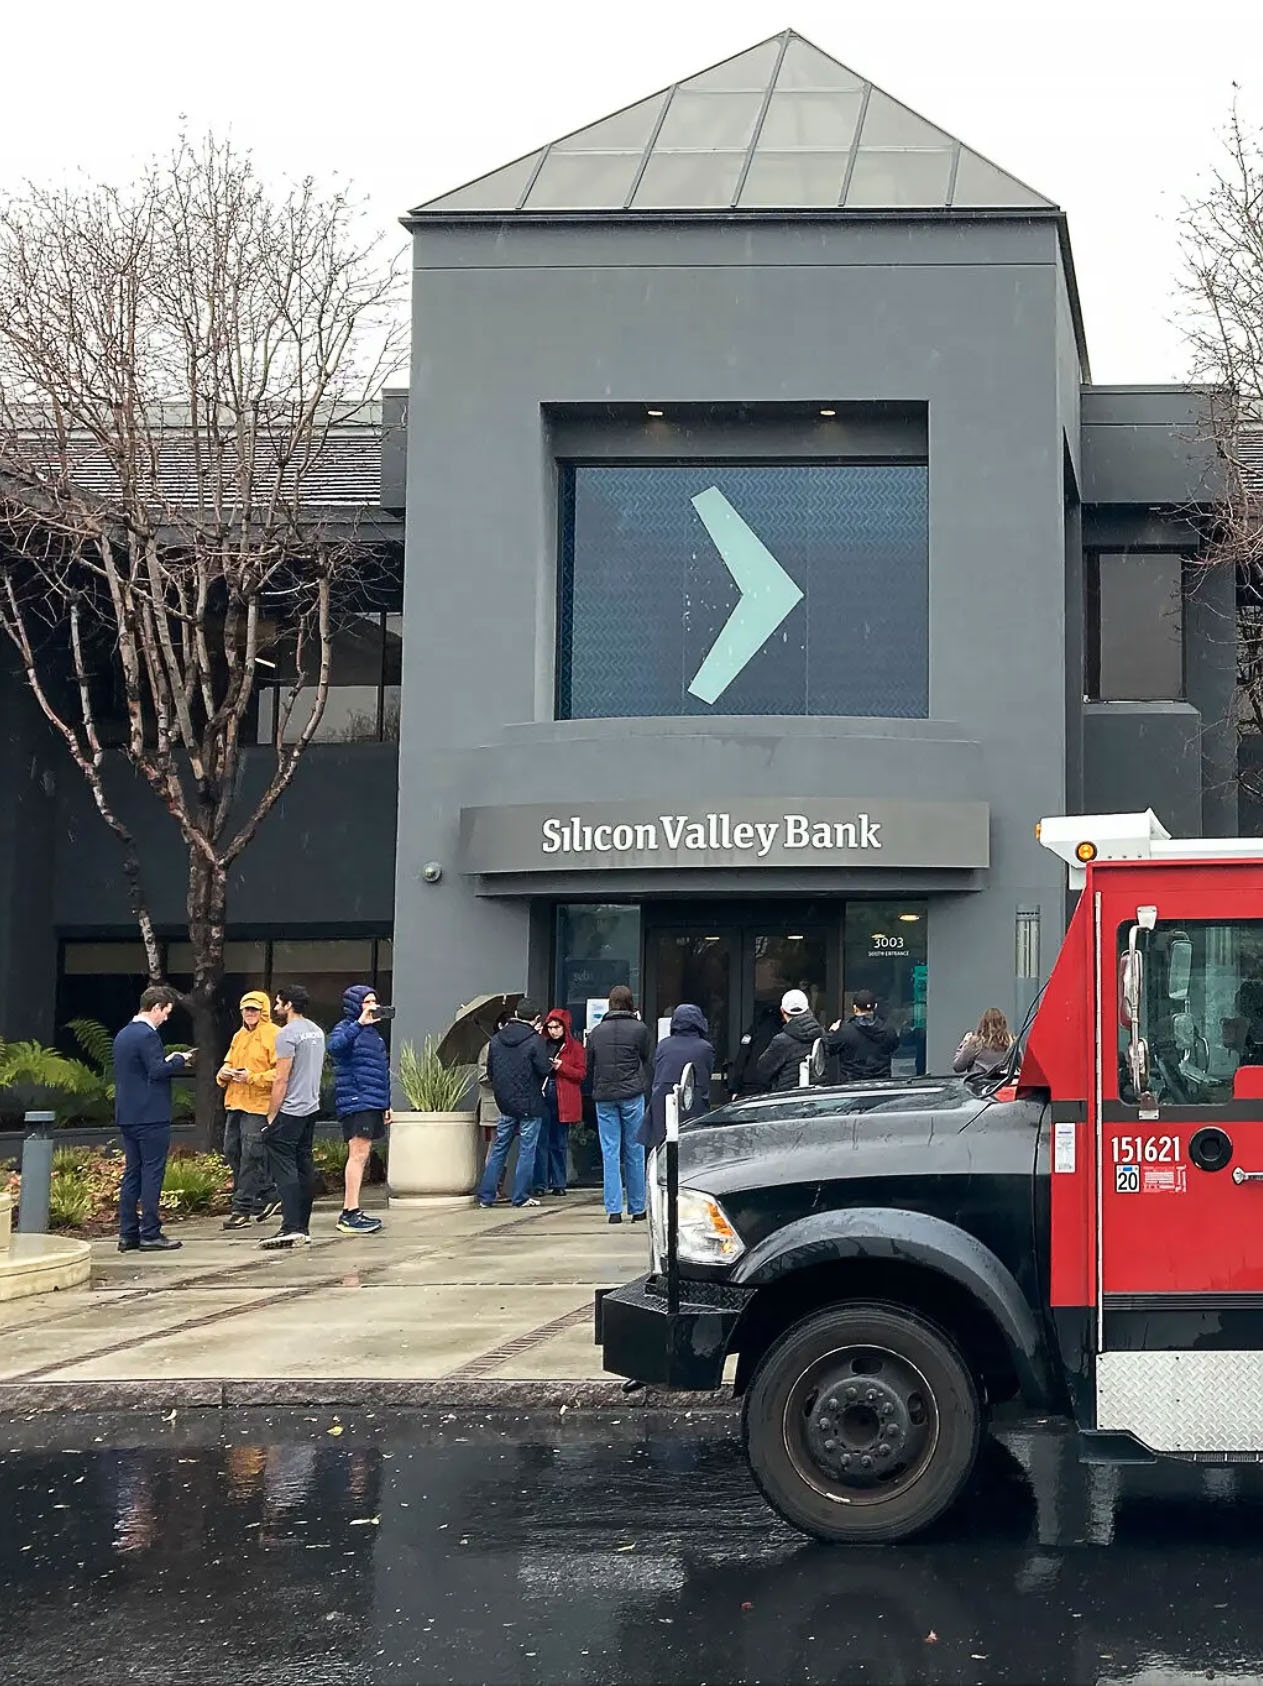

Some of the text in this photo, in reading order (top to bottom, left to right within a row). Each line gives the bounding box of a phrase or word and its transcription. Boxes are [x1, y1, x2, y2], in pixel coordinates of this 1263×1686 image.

[659, 813, 779, 857] Valley
[783, 813, 882, 849] Bank
[873, 936, 904, 949] 3003
[1111, 1136, 1180, 1163] 151621
[1117, 1171, 1138, 1191] 20
